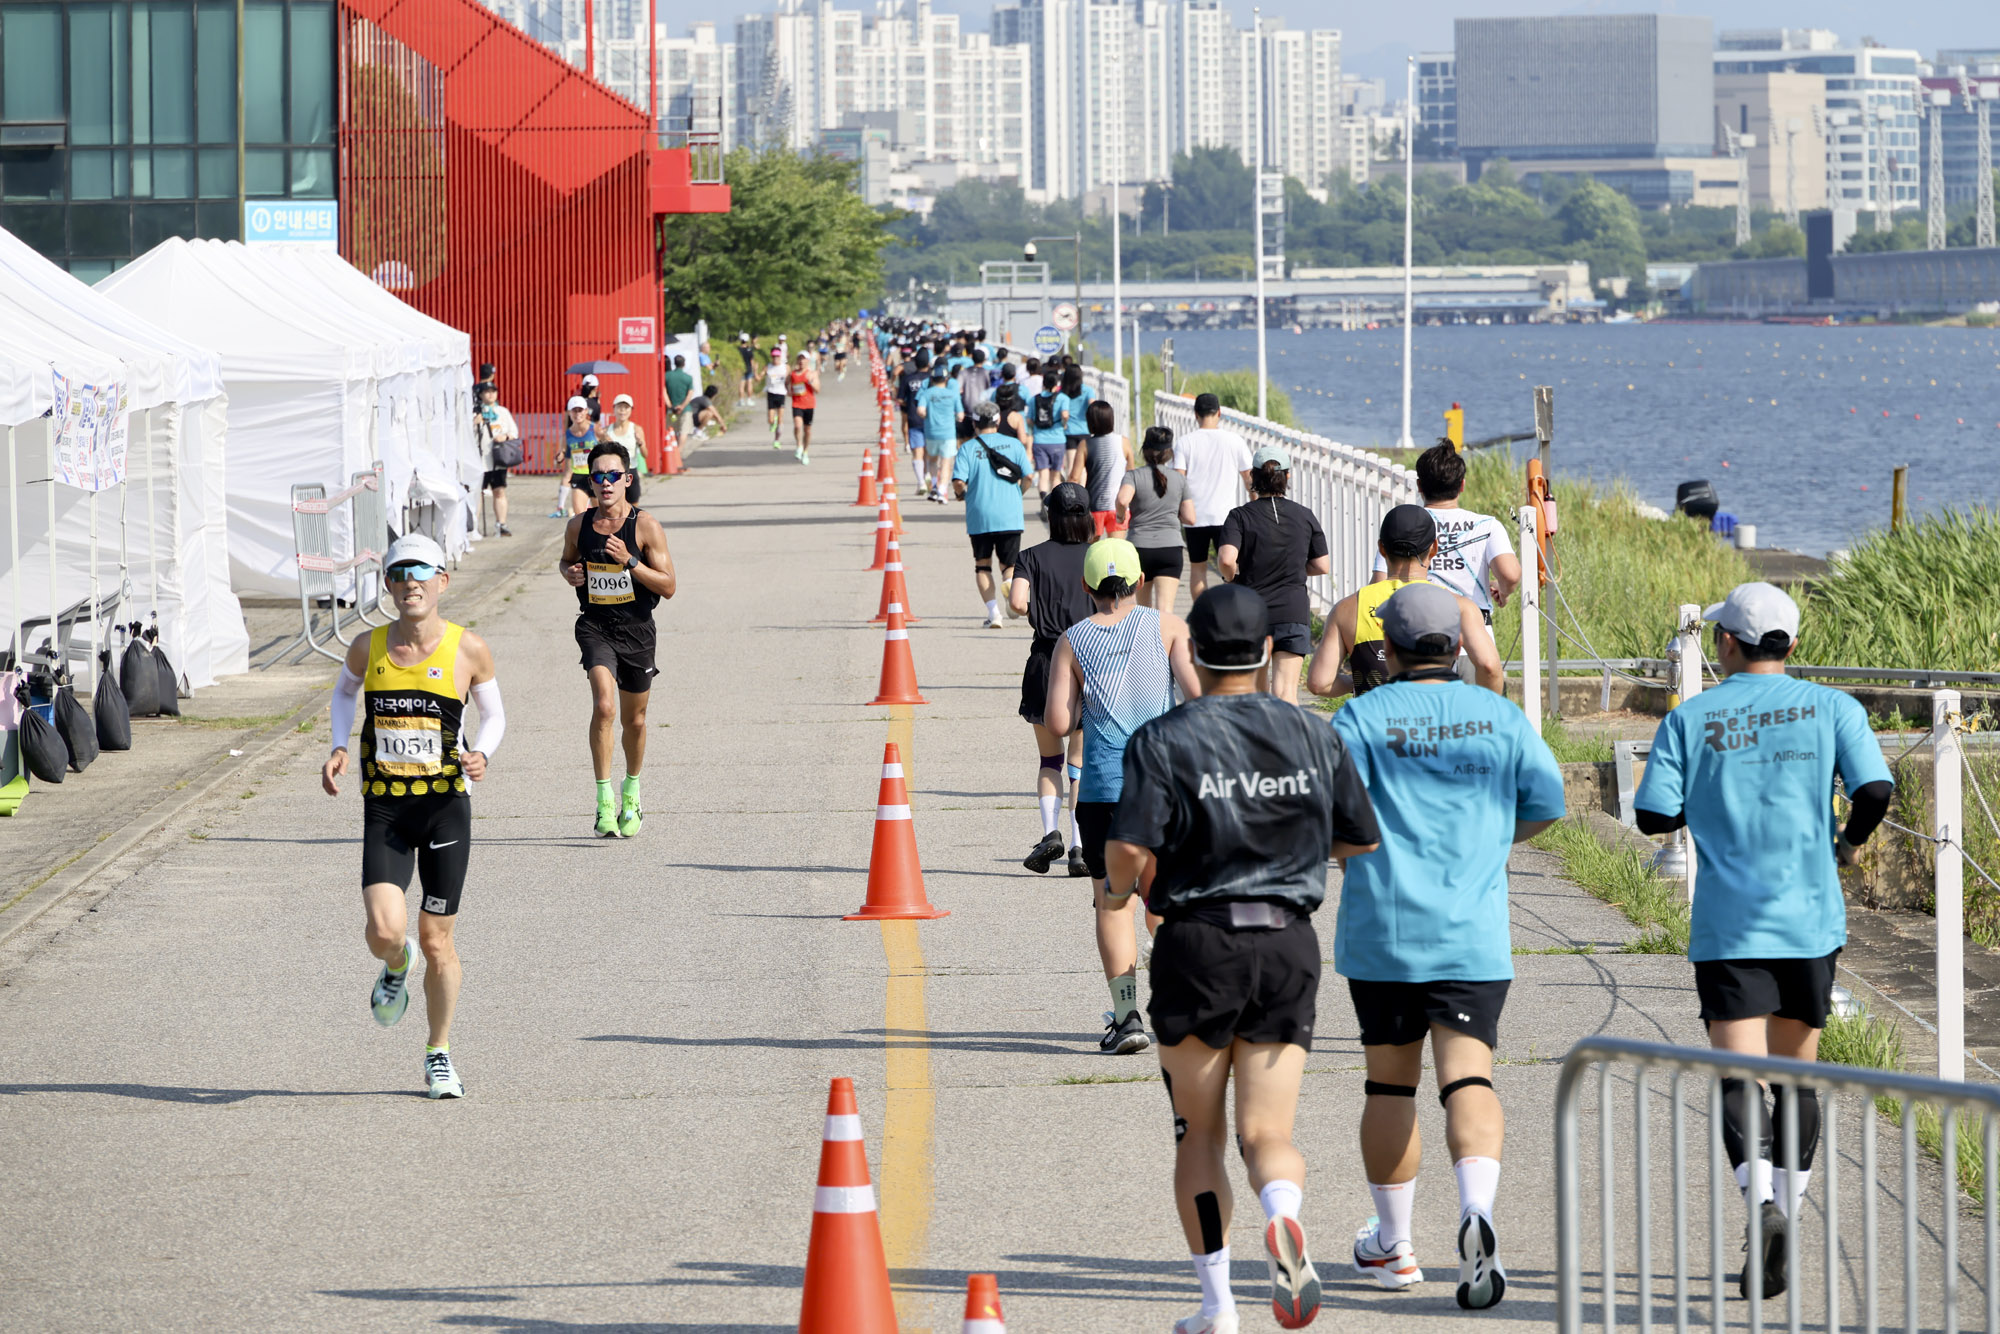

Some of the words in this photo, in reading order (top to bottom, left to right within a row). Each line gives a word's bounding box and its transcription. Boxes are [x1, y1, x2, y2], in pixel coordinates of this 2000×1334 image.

[273, 209, 332, 231] 안내센터
[1436, 521, 1474, 533] MAN
[1436, 532, 1458, 545] CE
[1436, 546, 1449, 558] N
[1428, 558, 1466, 571] ERS
[590, 576, 629, 591] 2096
[373, 697, 441, 713] 건국에이스
[1705, 708, 1729, 720] THE
[1733, 704, 1754, 716] 1ST
[1386, 717, 1409, 727] THE
[1413, 716, 1433, 727] 1ST
[382, 737, 435, 756] 1054
[1198, 771, 1237, 799] Air
